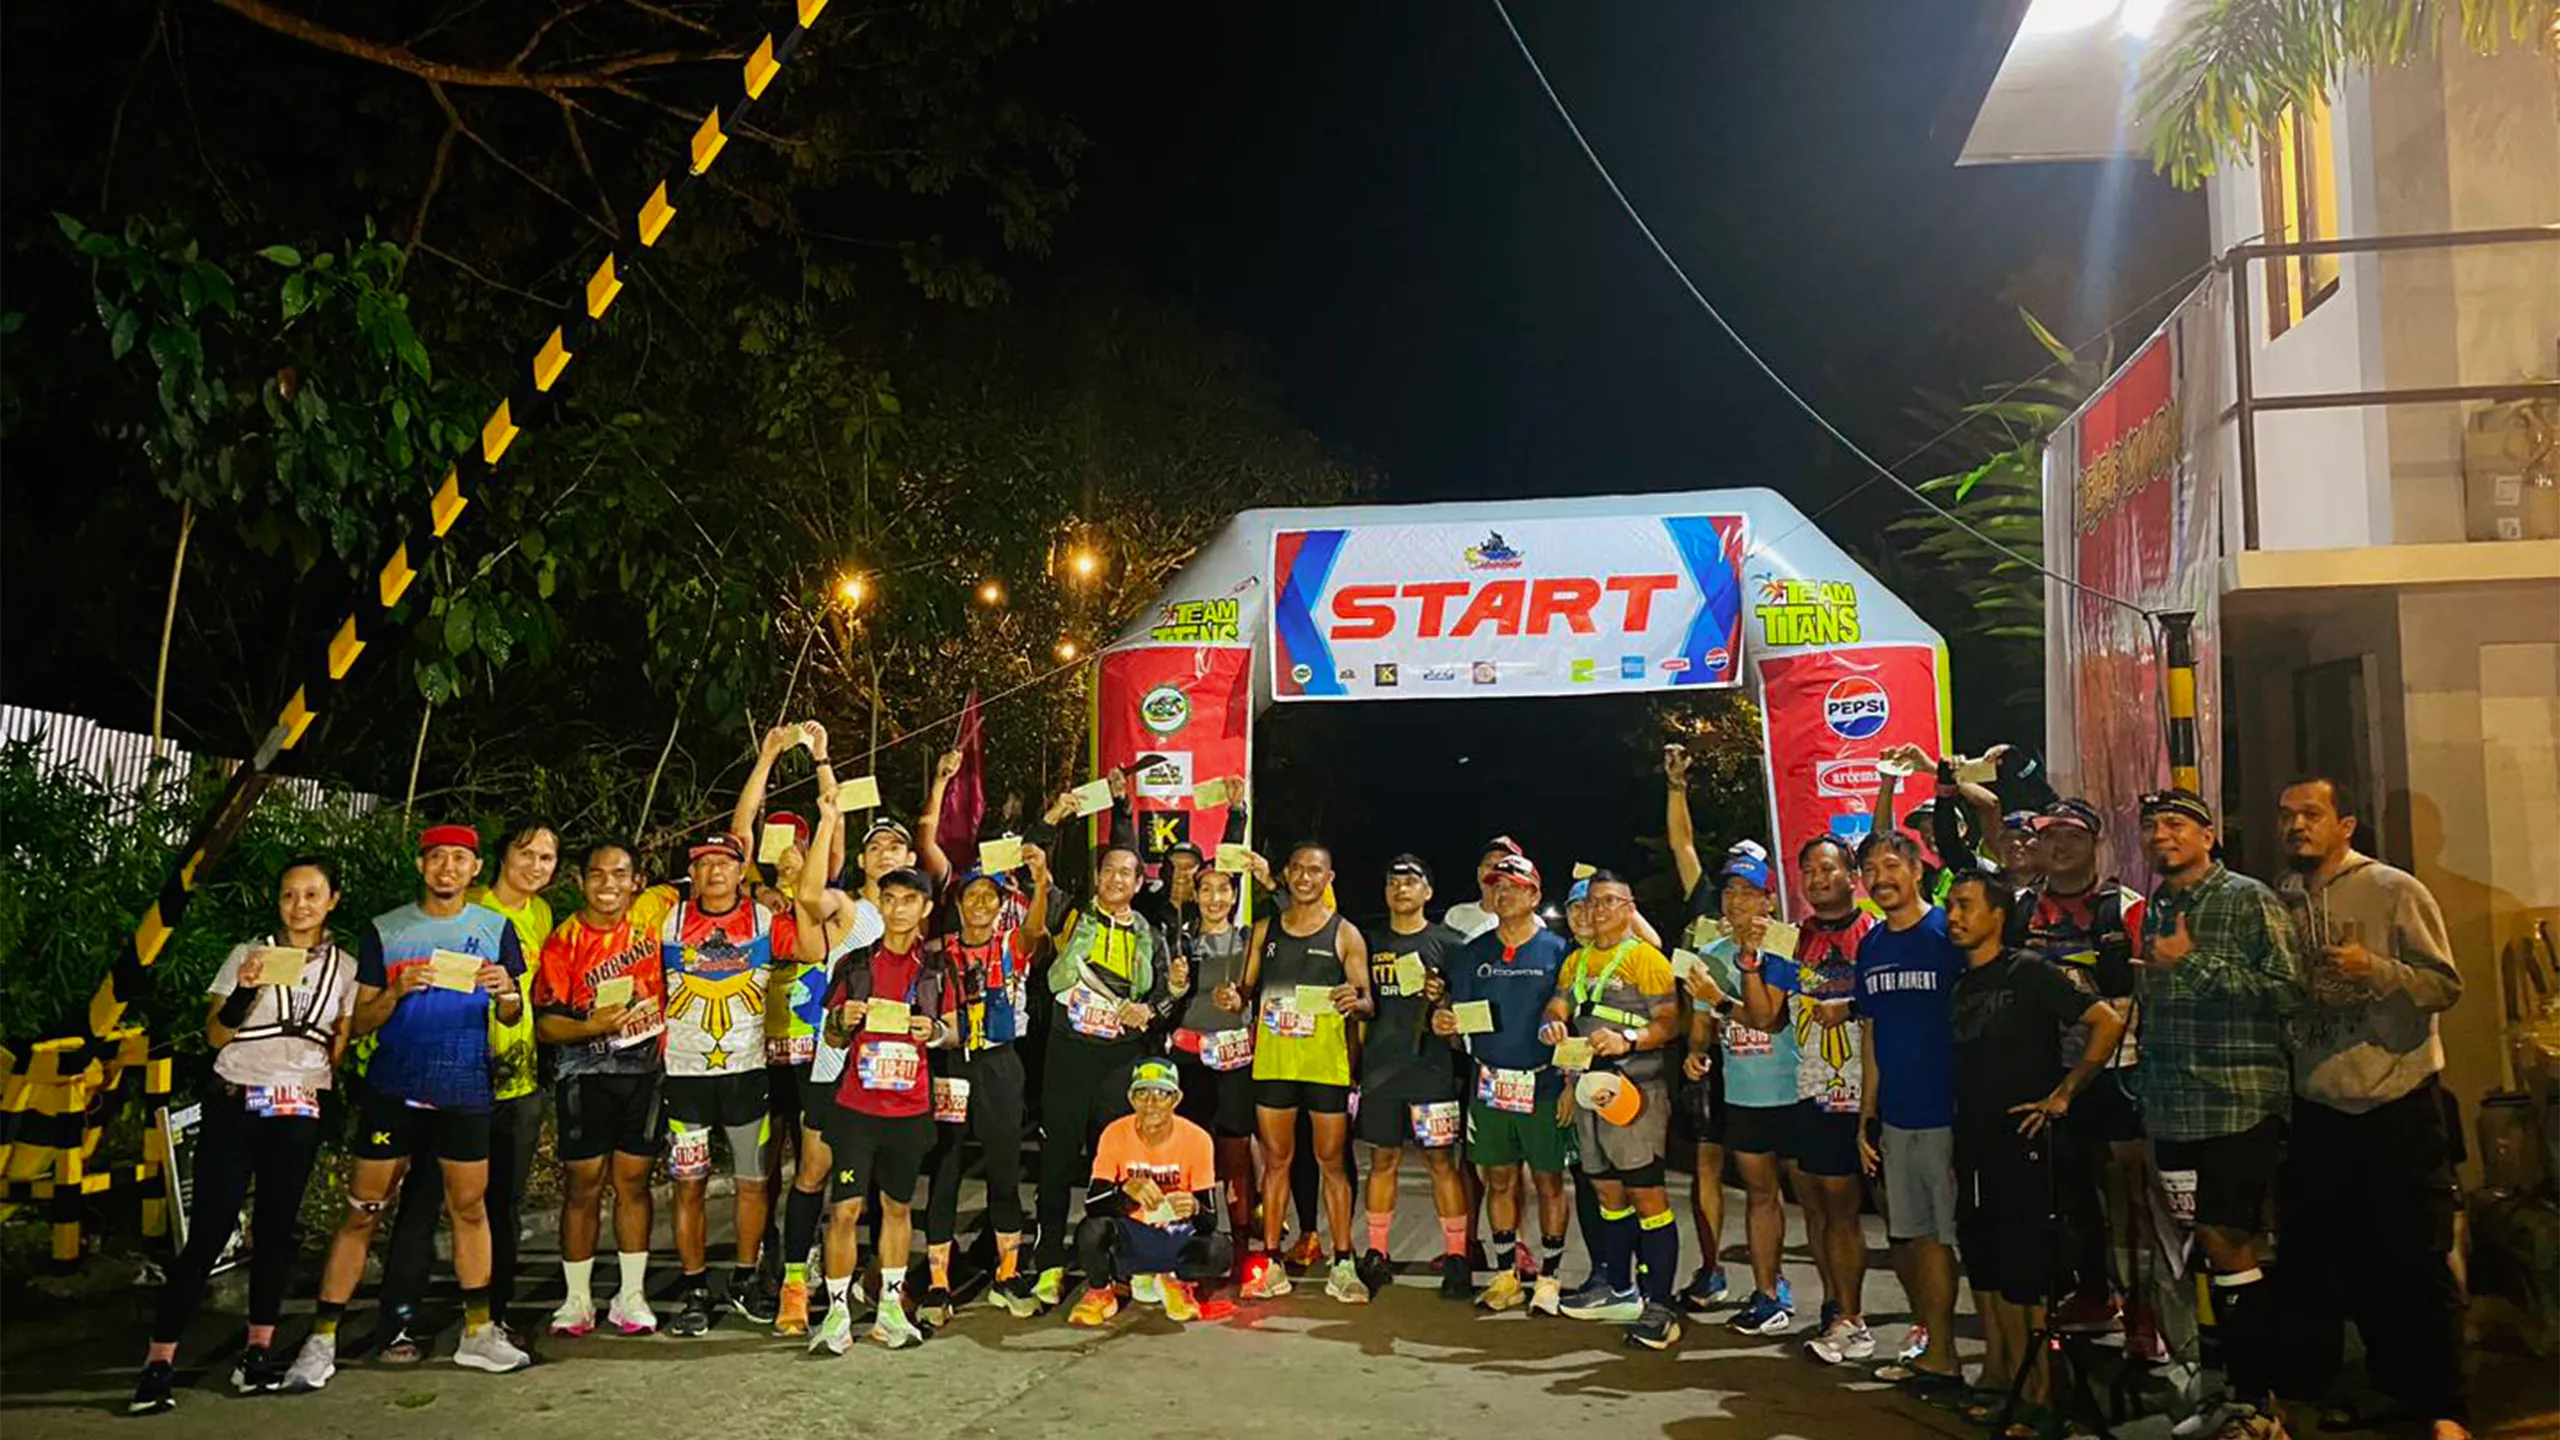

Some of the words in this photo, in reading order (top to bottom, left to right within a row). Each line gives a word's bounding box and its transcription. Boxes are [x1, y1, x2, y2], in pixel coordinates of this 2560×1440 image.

[1785, 579, 1854, 605] TEAM
[1176, 599, 1237, 624] TEAM
[1330, 574, 1678, 640] START
[1755, 603, 1860, 645] TITANS
[1828, 700, 1886, 715] PEPSI
